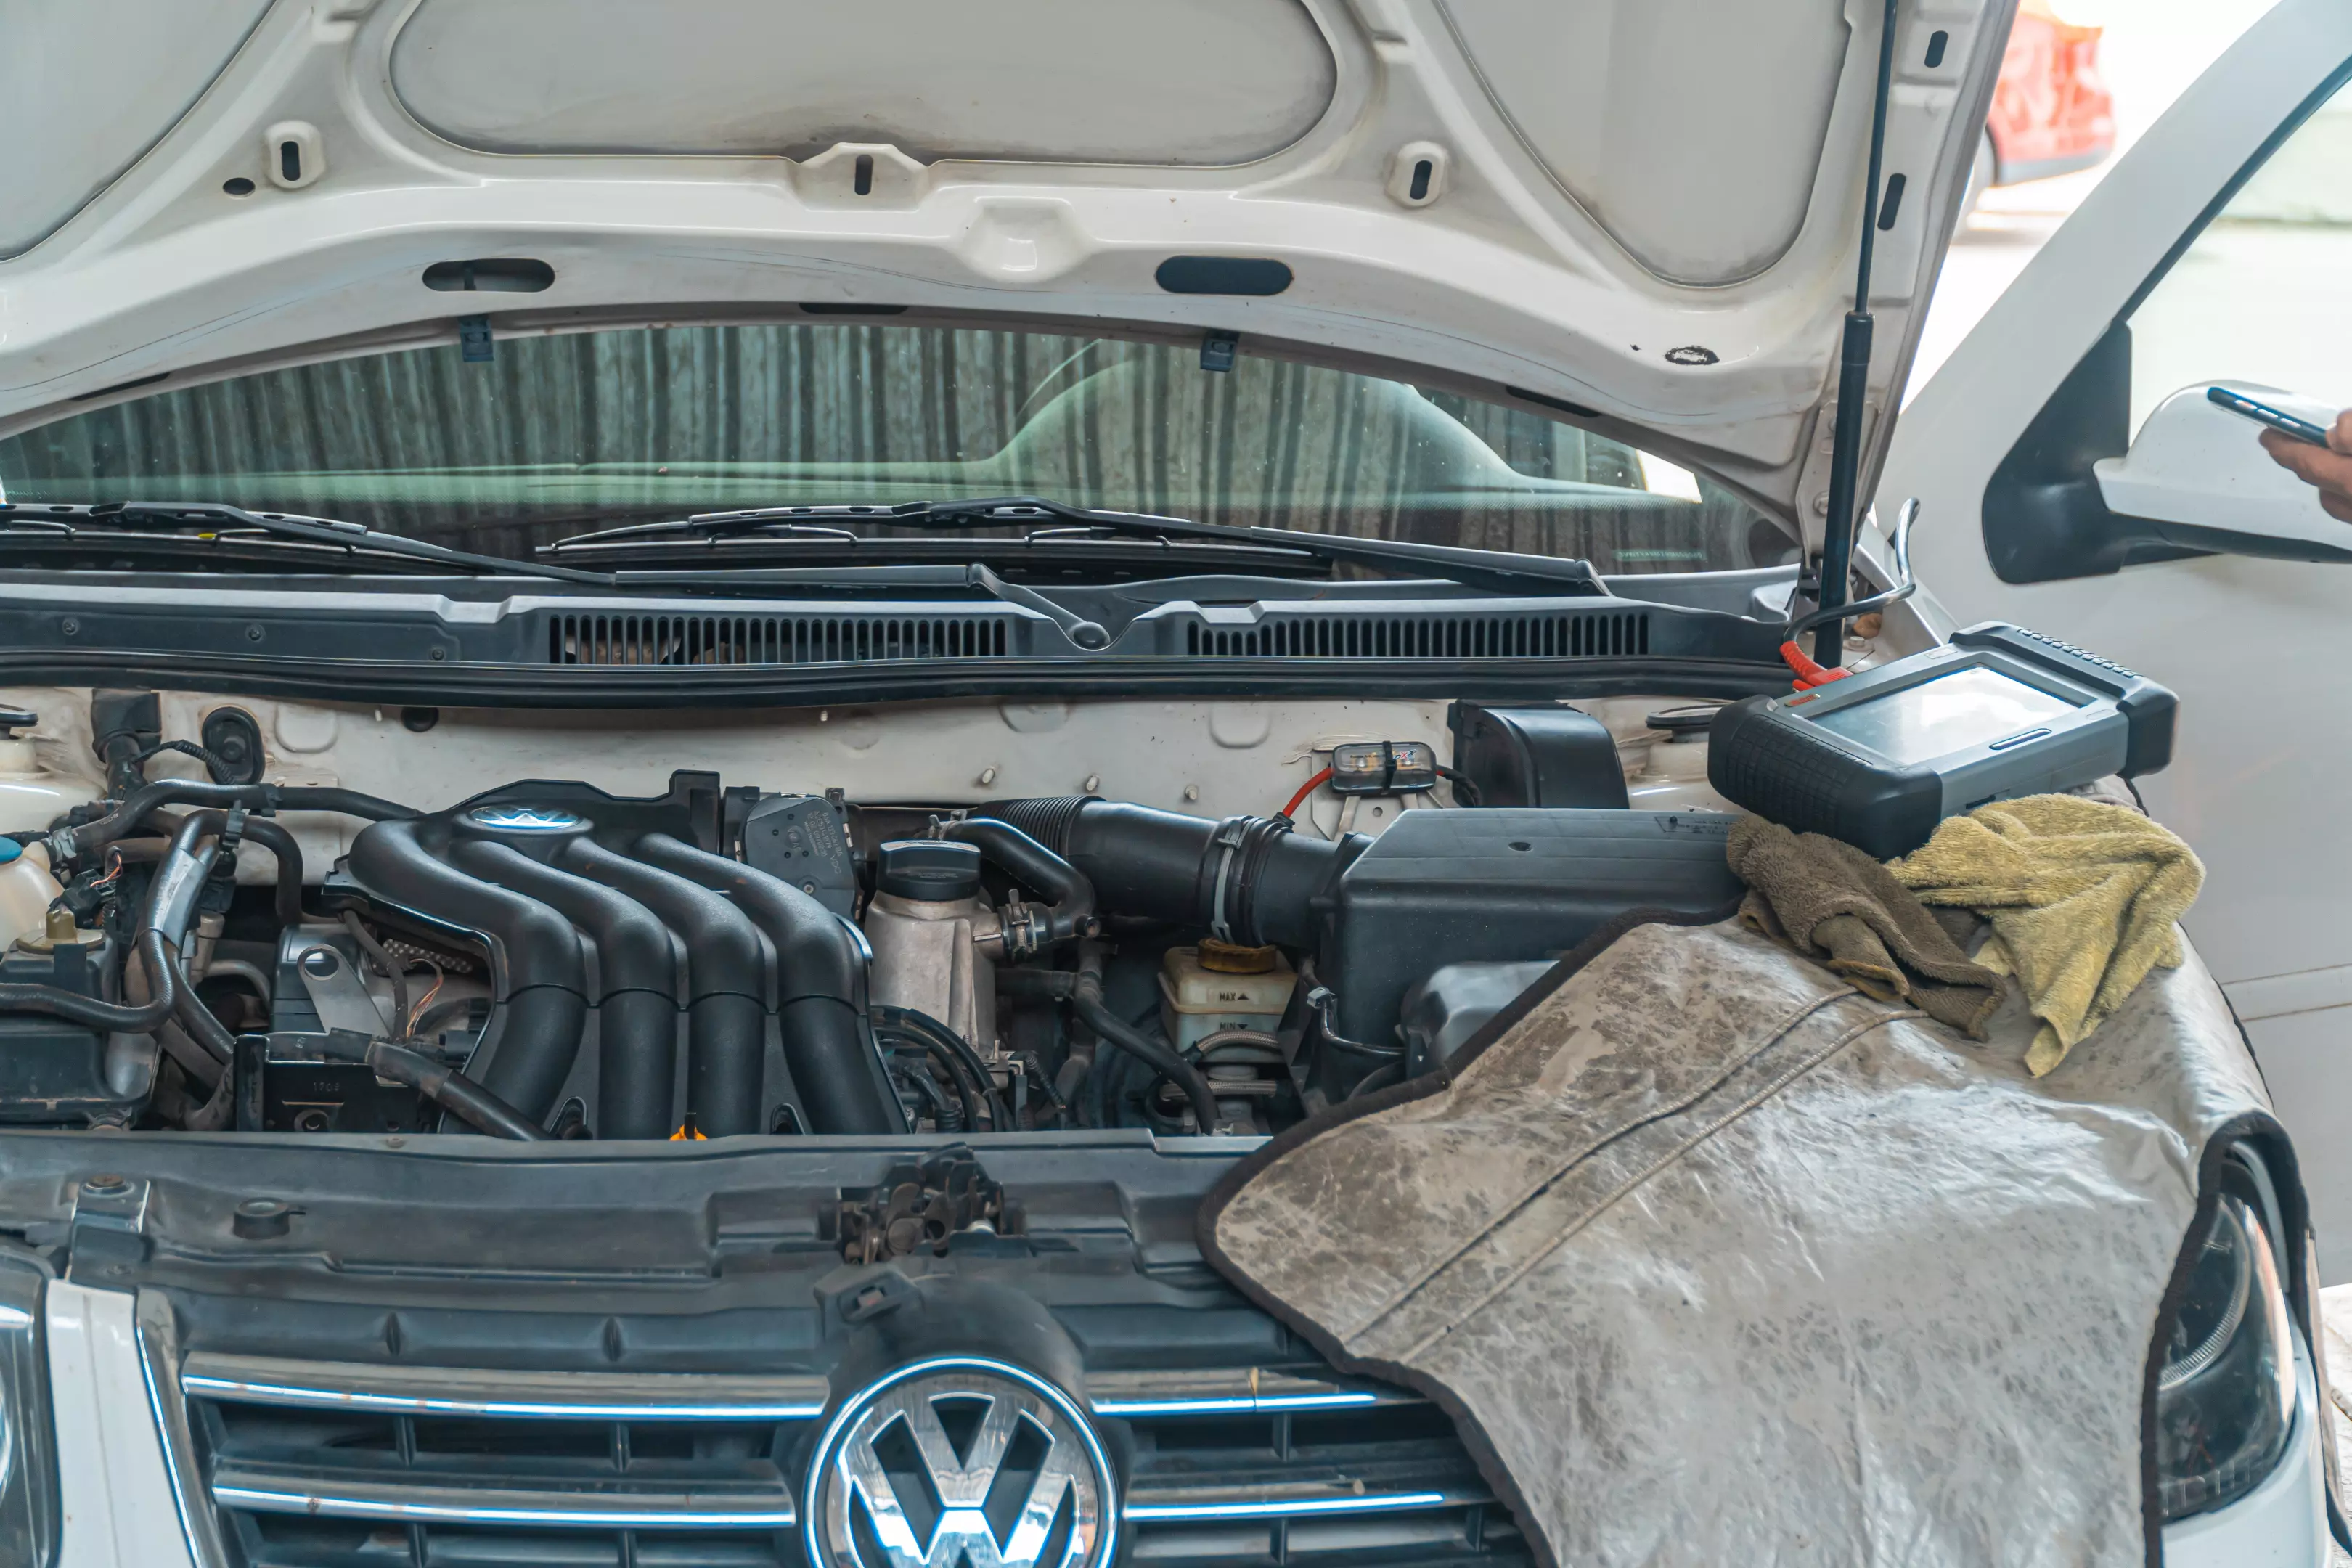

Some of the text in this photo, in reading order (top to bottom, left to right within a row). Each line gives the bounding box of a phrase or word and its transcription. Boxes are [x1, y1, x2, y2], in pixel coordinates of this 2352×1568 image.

[1219, 992, 1236, 1002] MAX
[1220, 1021, 1236, 1031] MIN
[817, 1363, 1108, 1568] VW
